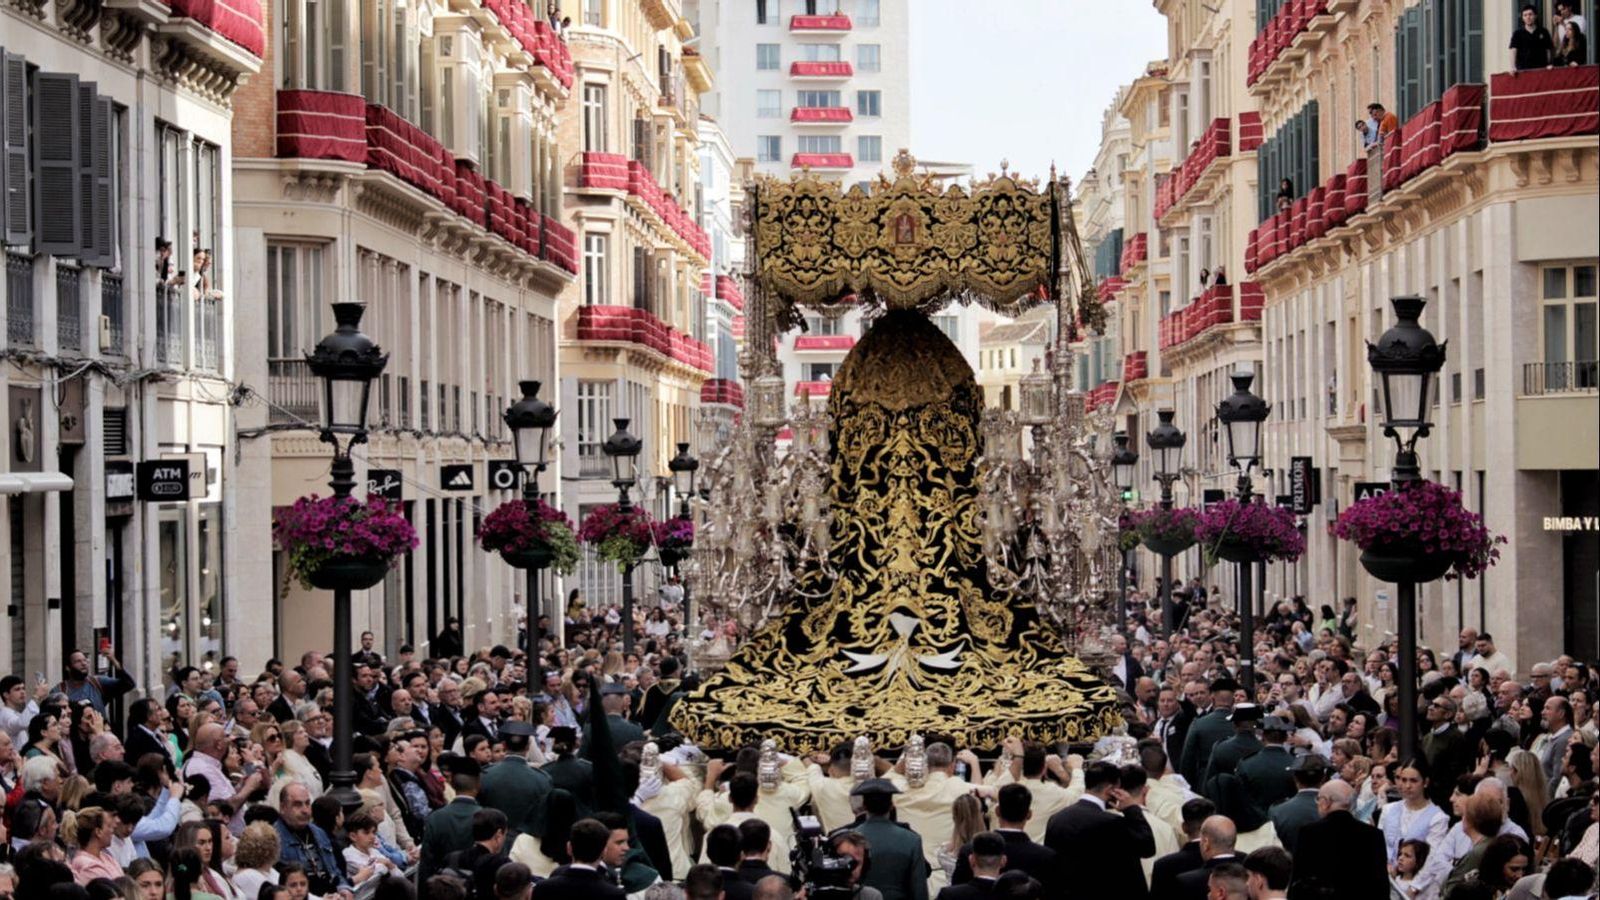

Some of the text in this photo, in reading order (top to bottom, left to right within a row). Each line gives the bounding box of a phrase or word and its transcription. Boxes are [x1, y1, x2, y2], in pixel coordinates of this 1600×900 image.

[152, 467, 182, 480] ATM
[1293, 460, 1304, 511] PRIMOR
[1543, 516, 1582, 531] BIMBA
[1583, 516, 1593, 531] Y
